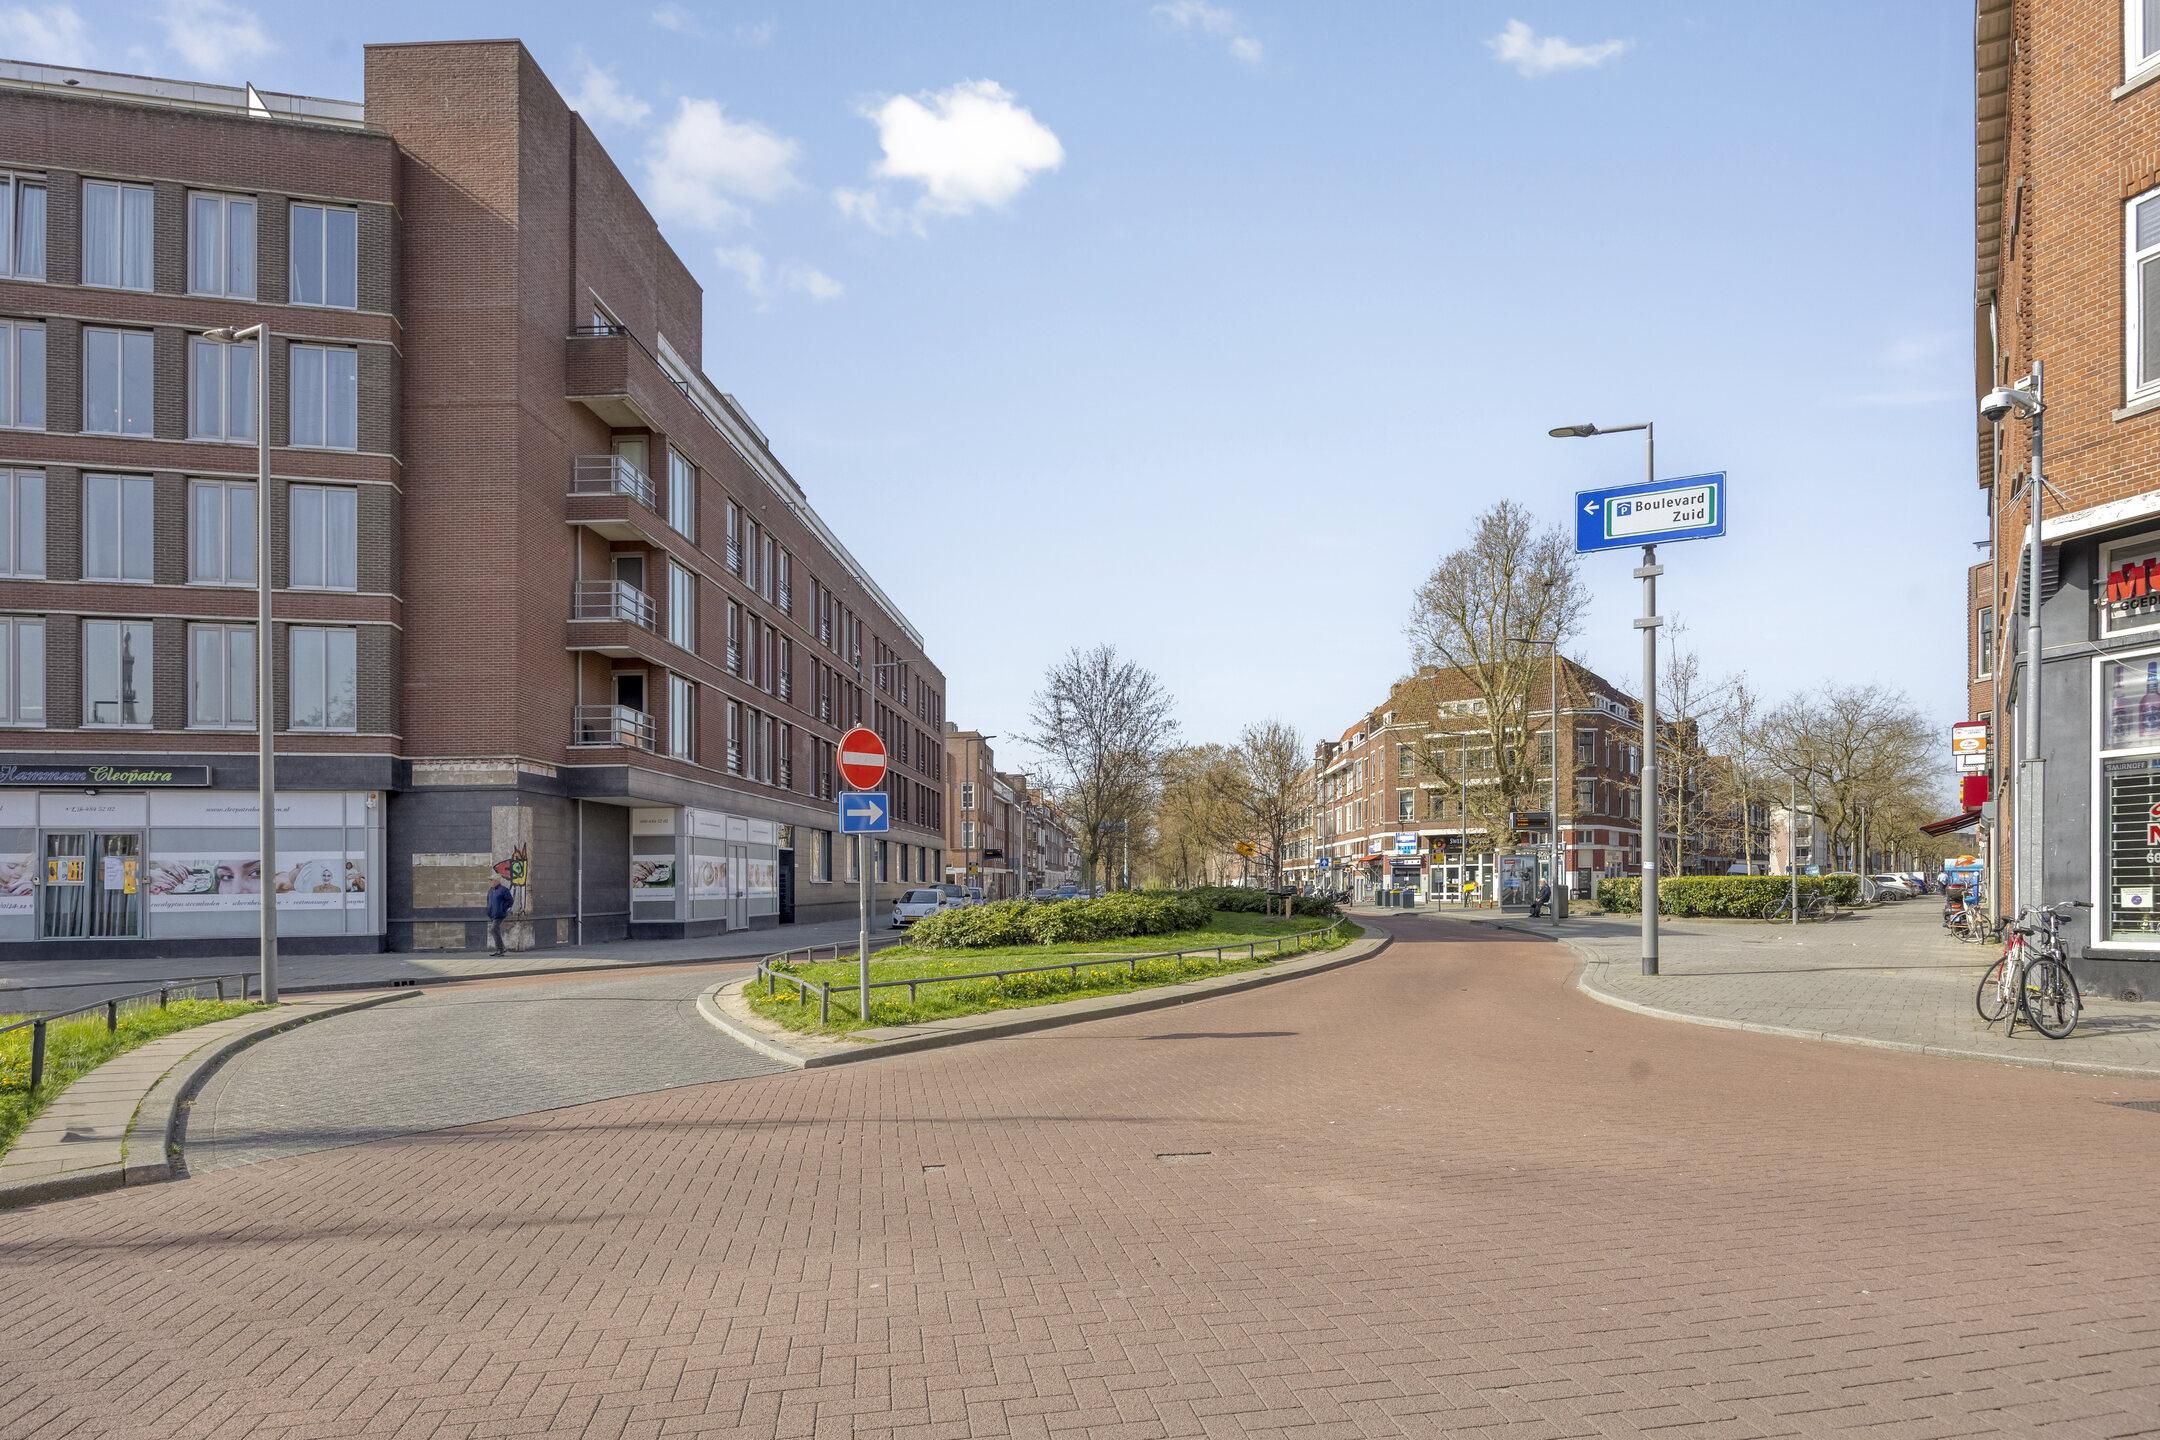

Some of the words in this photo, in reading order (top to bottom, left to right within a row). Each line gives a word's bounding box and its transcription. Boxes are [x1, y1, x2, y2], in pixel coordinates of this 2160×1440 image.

[1635, 492, 1705, 512] Boulevard
[1672, 508, 1705, 522] Zuid
[2121, 595, 2160, 610] GOED
[2106, 760, 2146, 772] SMIRNOFF
[0, 765, 87, 782] Hammam
[89, 766, 173, 784] Cleopatra
